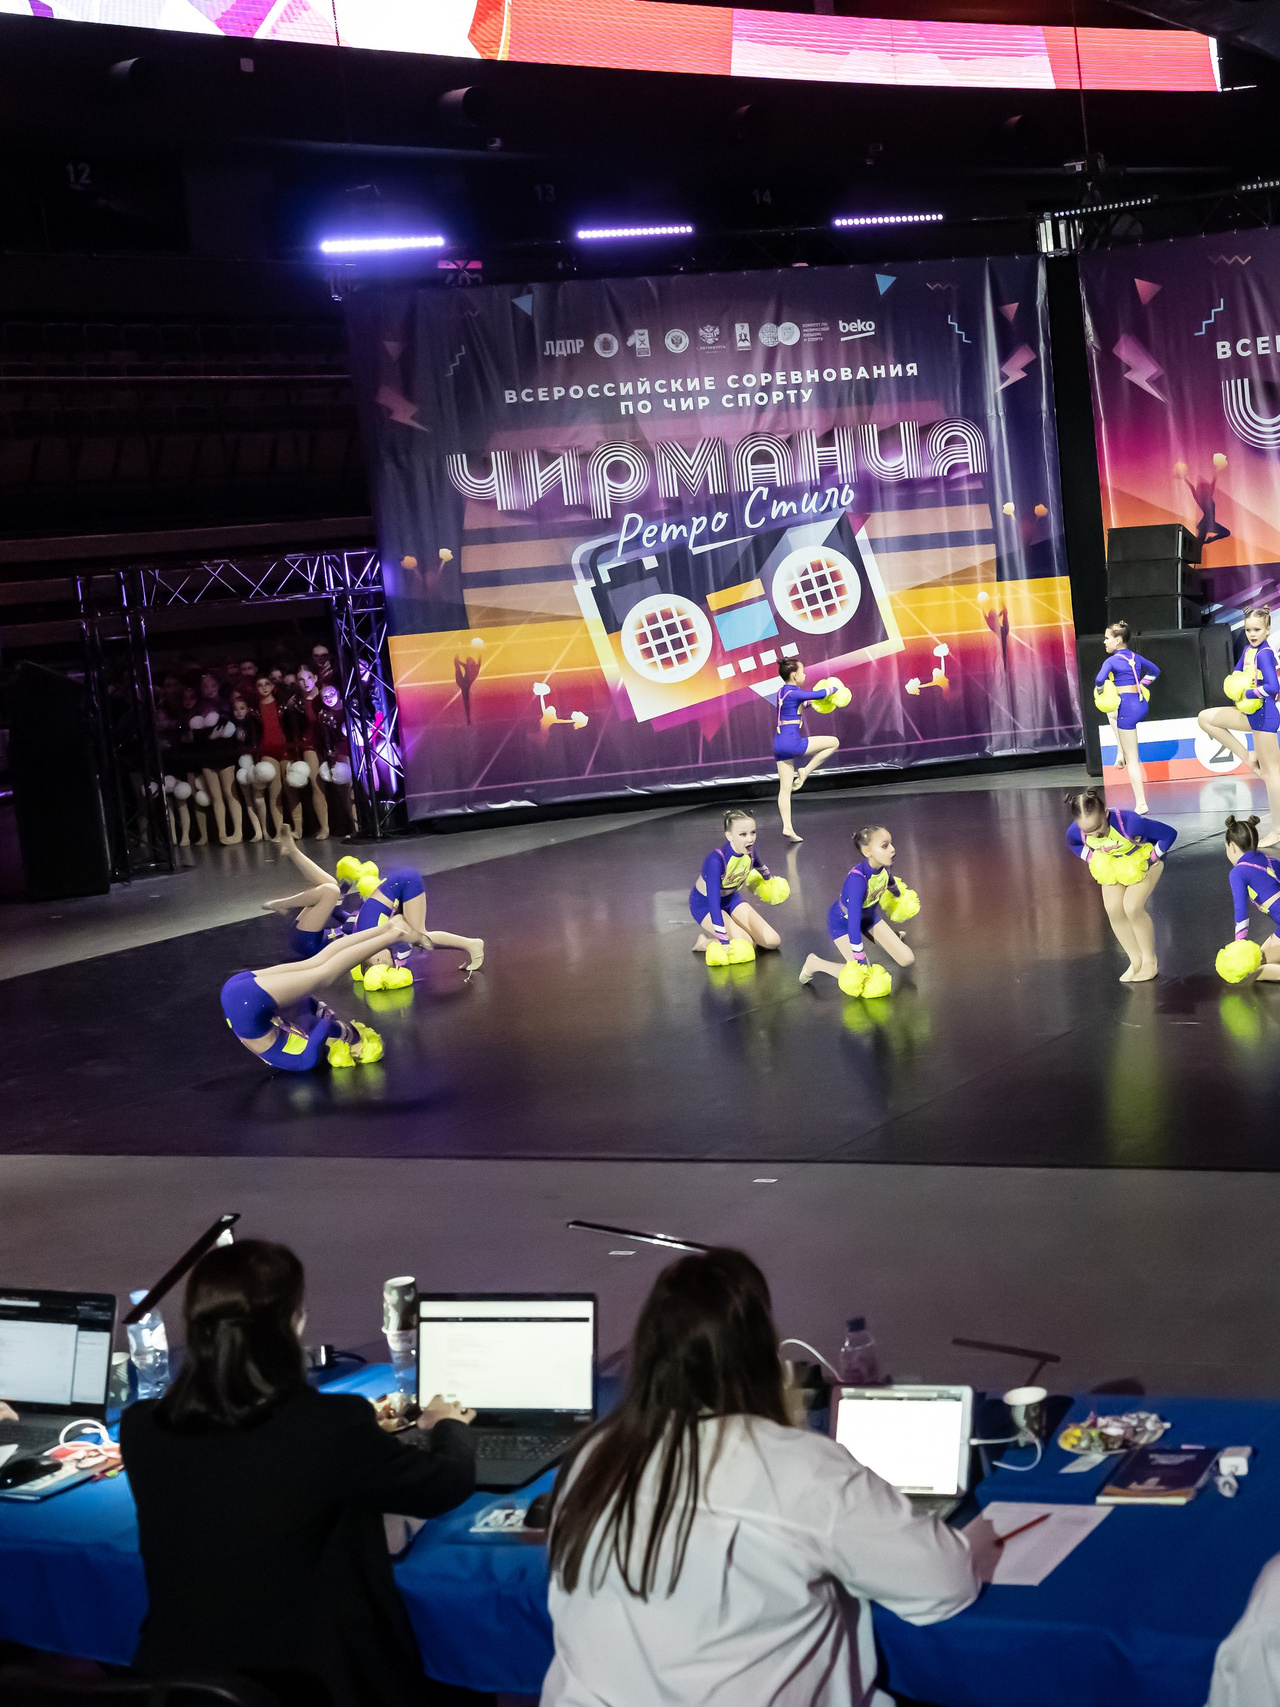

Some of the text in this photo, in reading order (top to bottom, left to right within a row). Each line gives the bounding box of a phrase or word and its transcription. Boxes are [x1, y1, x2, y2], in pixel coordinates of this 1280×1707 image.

[65, 161, 92, 184] 12
[838, 318, 876, 333] beko
[543, 338, 584, 357] ЛДПР
[504, 362, 919, 404] ВСЕРОССИЙСКИЕ СОРЕВНОВАНИЯ
[620, 388, 814, 415] ПО ЧИР СПОРТУ
[617, 484, 855, 557] Ретро Стиль
